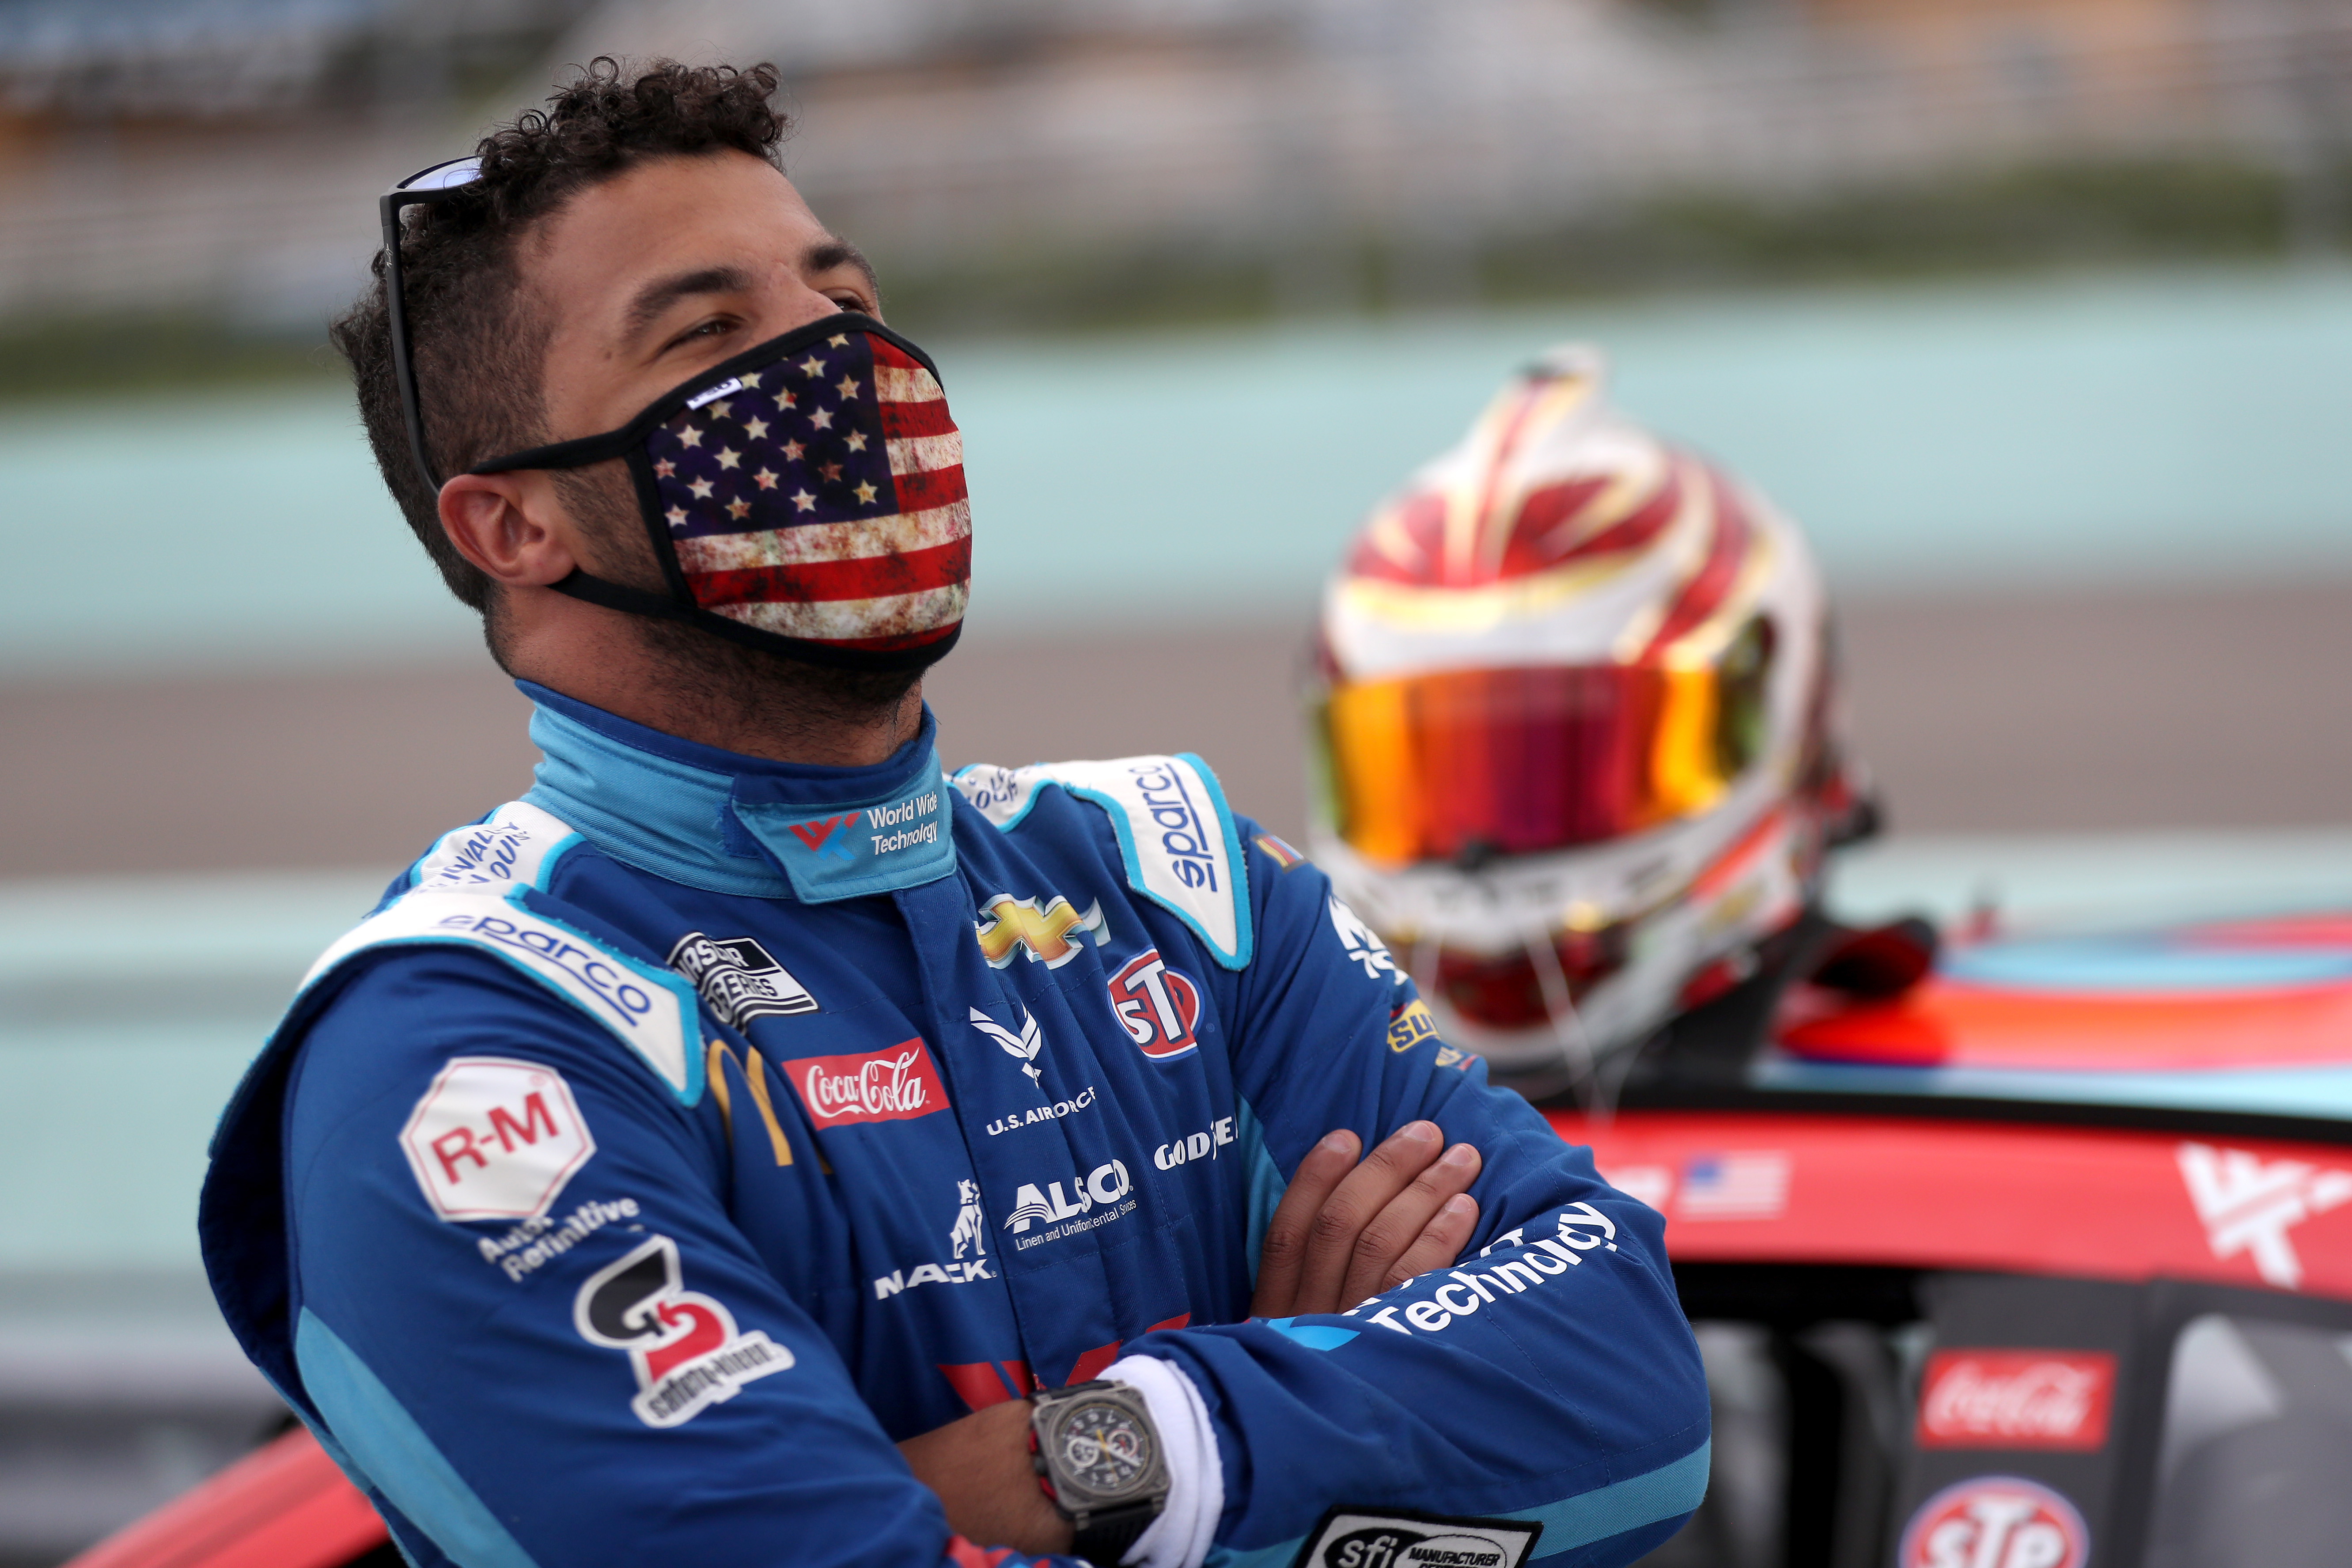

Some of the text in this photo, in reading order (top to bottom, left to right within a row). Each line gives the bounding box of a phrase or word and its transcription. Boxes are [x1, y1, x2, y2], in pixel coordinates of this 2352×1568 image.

[867, 791, 938, 829] World Wide
[871, 820, 938, 856] Technology
[1128, 764, 1215, 890] sparco
[437, 914, 651, 1016] sparco
[1116, 959, 1184, 1045] ST
[807, 1046, 927, 1118] Coca-Cola
[431, 1091, 559, 1185] R-M
[986, 1114, 1024, 1136] U.S.
[1026, 1106, 1056, 1125] AIR
[1003, 1159, 1130, 1234] ALSCO
[1015, 1233, 1044, 1251] Linen
[1045, 1226, 1060, 1242] and
[1408, 1546, 1501, 1567] MANUFACTURER
